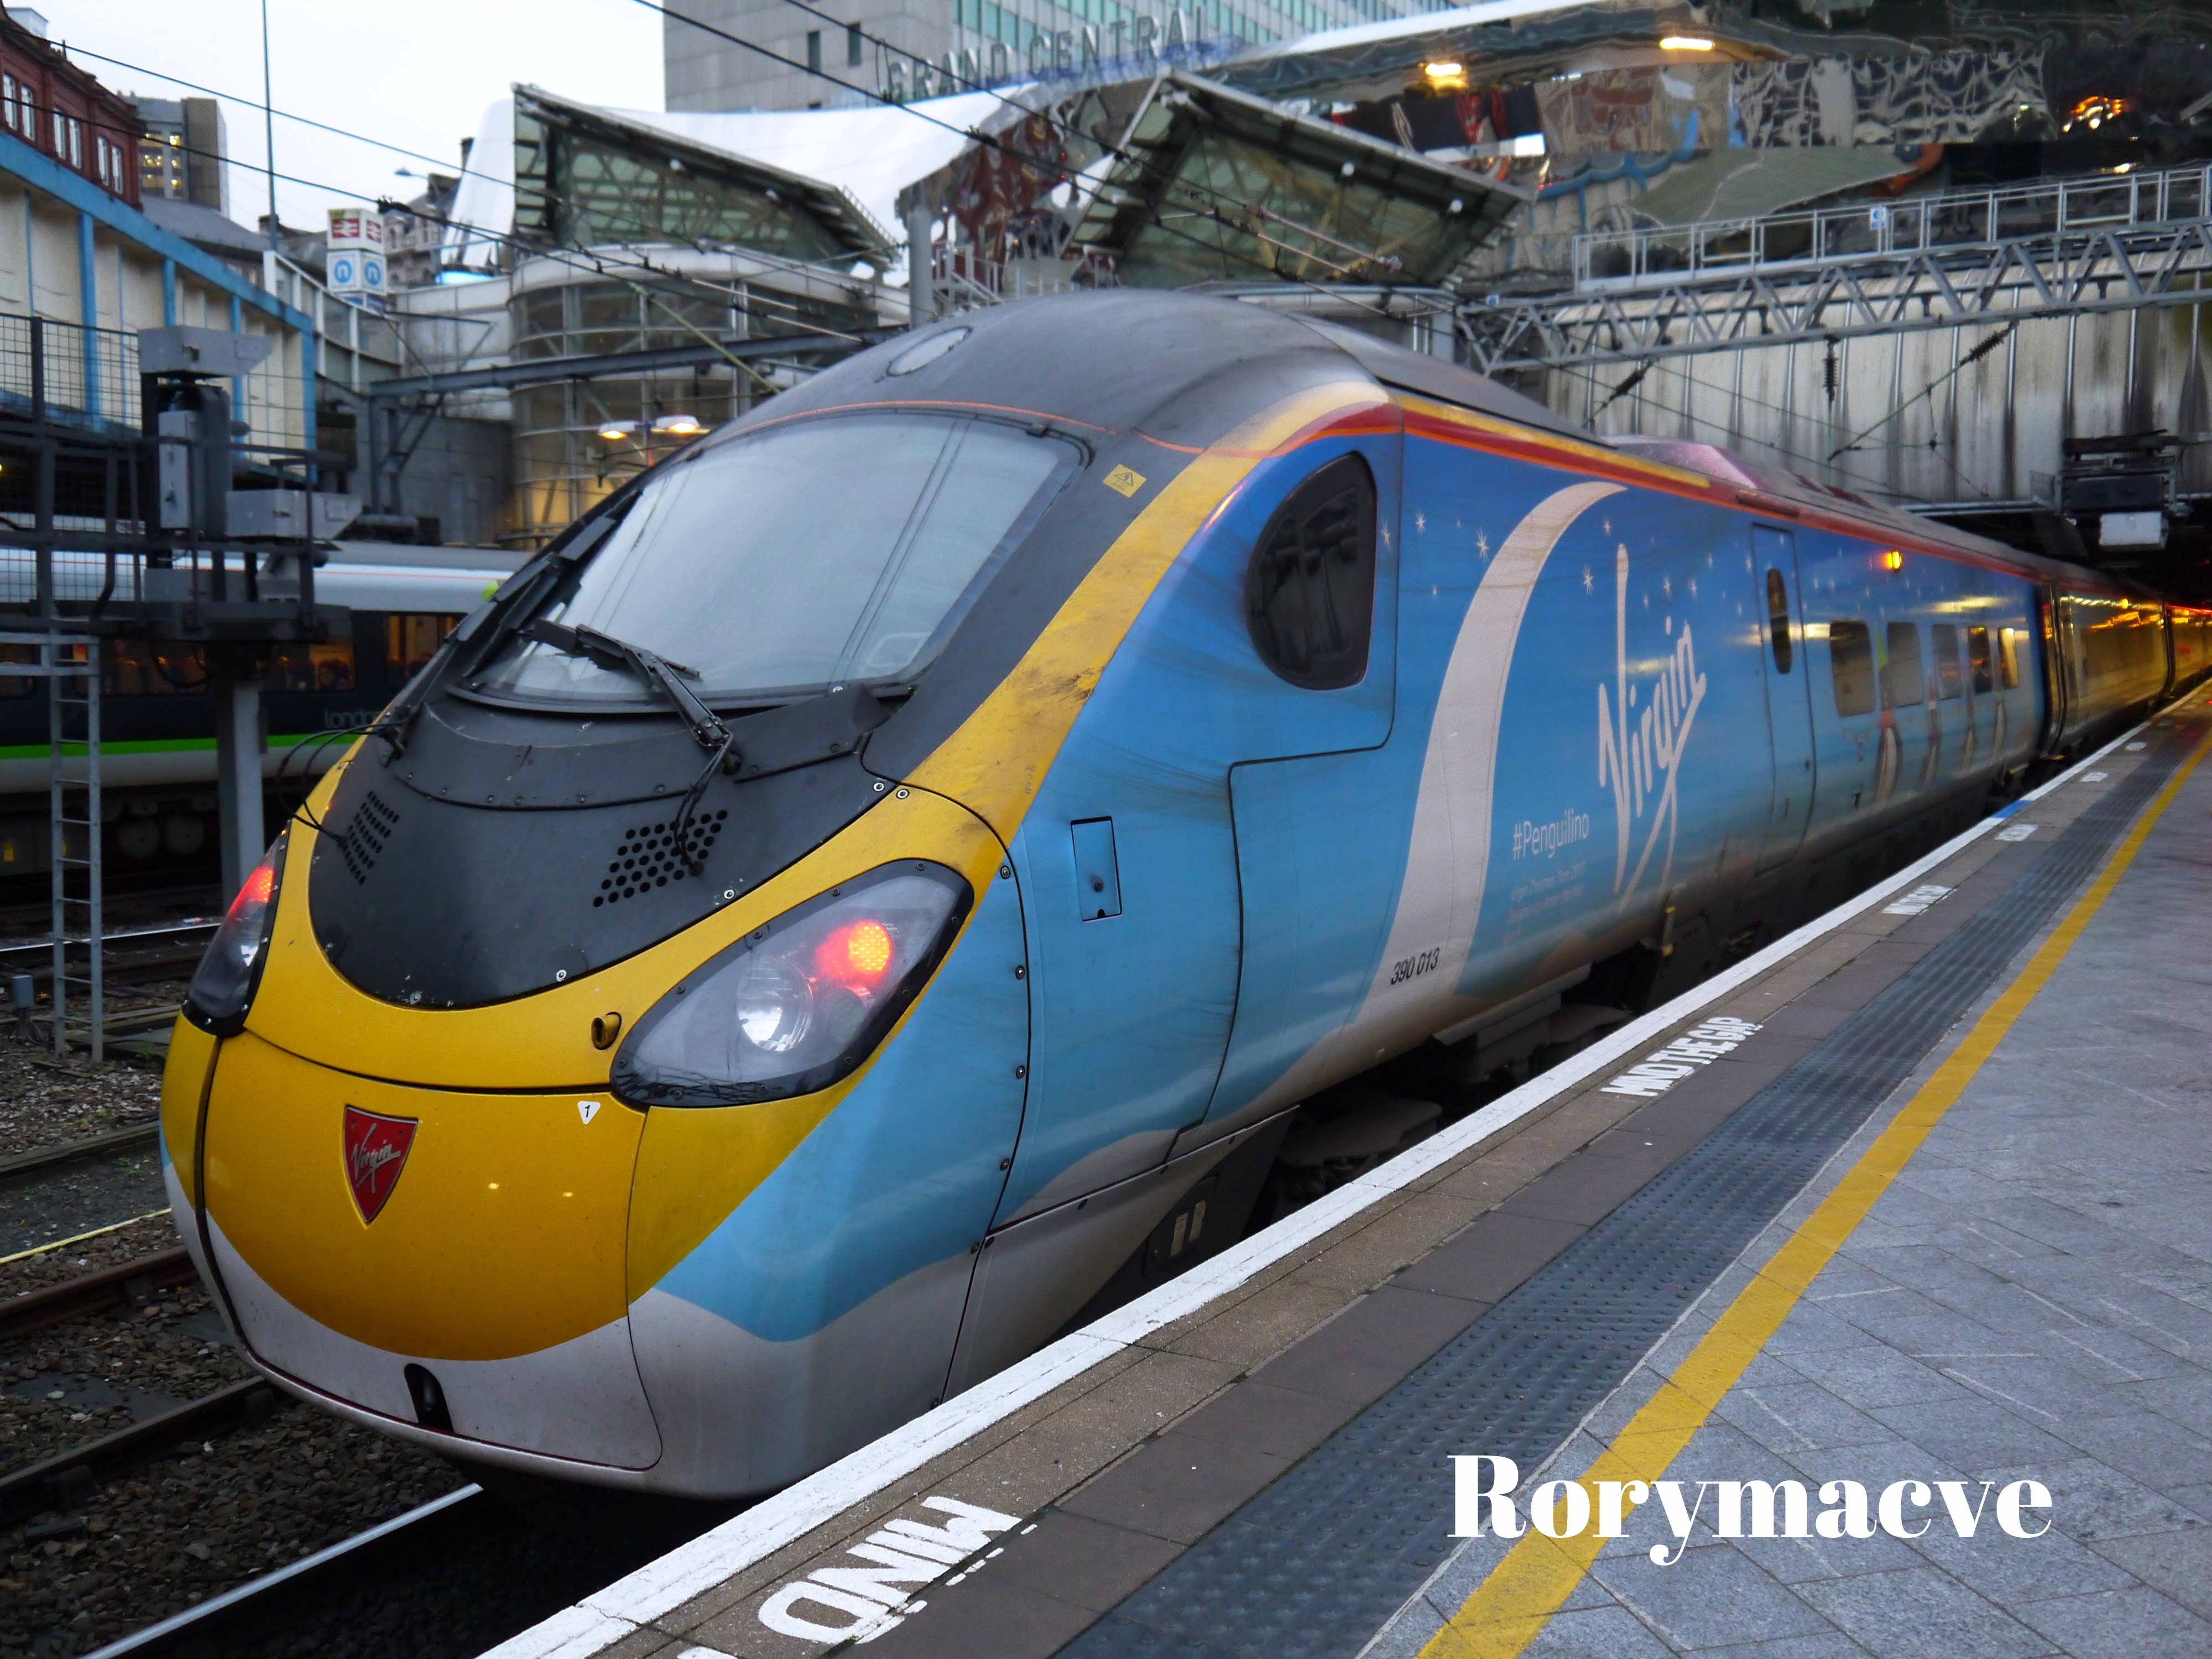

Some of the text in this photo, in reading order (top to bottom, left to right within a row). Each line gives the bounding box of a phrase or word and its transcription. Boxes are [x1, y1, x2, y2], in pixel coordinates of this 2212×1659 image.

[886, 6, 1214, 105] GRAND CENTRAL
[1599, 543, 1707, 914] Virgin
[1513, 808, 1589, 861] #Penguilino
[1391, 947, 1441, 985] 390 013
[1600, 1016, 1764, 1097] MIND THE GAP
[585, 1104, 591, 1118] 1
[351, 1123, 401, 1194] Virgin
[757, 1495, 1038, 1645] MIND
